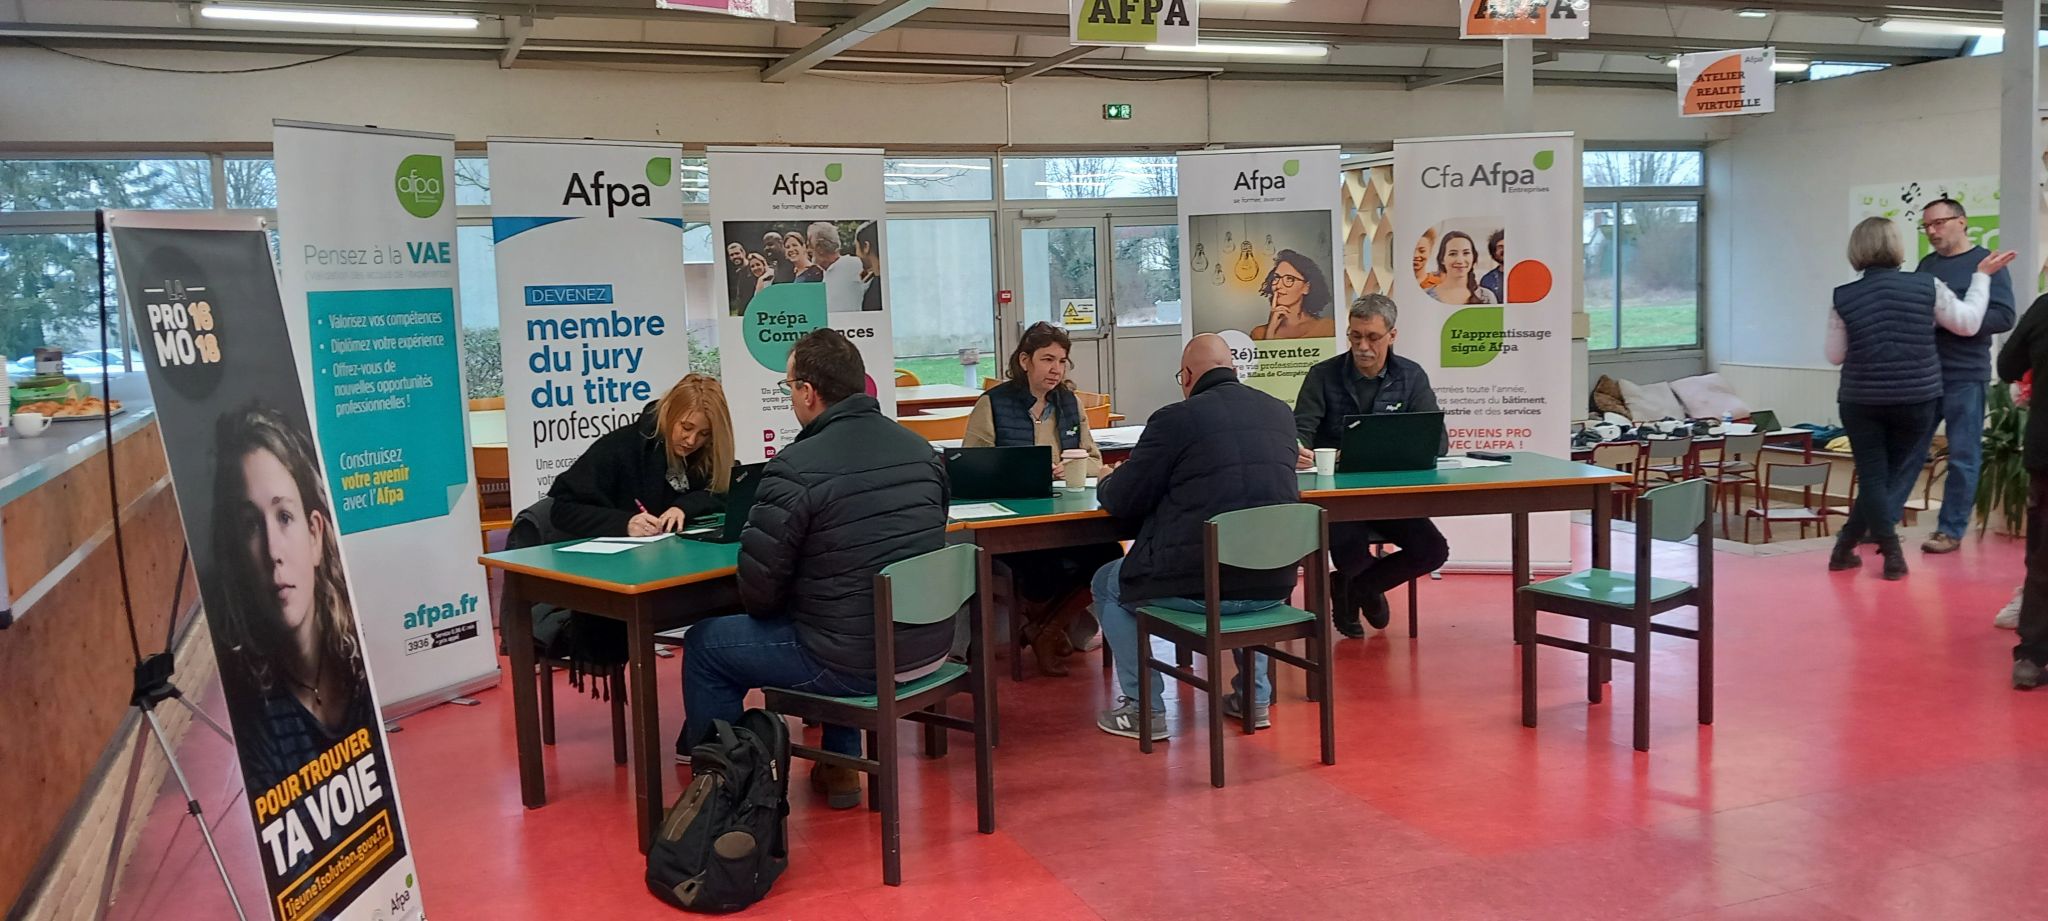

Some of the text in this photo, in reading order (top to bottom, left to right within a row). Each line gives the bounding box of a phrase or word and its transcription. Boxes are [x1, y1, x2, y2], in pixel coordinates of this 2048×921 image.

[1088, 0, 1190, 26] AFPA
[1474, 0, 1578, 19] APA
[1696, 71, 1745, 82] ATELIER
[1697, 85, 1746, 96] REALITE
[1697, 98, 1761, 110] VIRTUELLE
[398, 169, 440, 203] afpa
[772, 172, 829, 203] Afpa
[1233, 169, 1285, 196] Afpa
[1421, 161, 1535, 194] Cfa Afpa
[562, 171, 651, 218] Afpa
[1508, 186, 1549, 195] Entreprises
[304, 241, 452, 266] Pensez à la VAE
[532, 288, 607, 303] DEVENEZ
[147, 303, 189, 331] PRO
[328, 311, 442, 329] Valorisez vos compétences
[527, 310, 665, 341] membre
[757, 311, 808, 328] Prépa
[331, 333, 444, 354] Diplômez votre expérience
[1451, 328, 1552, 341] L'apprentissage
[153, 329, 197, 367] MO
[529, 343, 643, 376] du jury
[1231, 346, 1320, 362] Ré)inventez
[1451, 342, 1519, 354] signé Afpa
[332, 359, 396, 377] Offrez-vous de
[334, 373, 433, 397] nouvelles opportunités
[531, 376, 651, 409] du titre
[1466, 385, 1490, 394] toute
[335, 395, 406, 418] professionnelles
[1449, 396, 1486, 405] secteurs
[1488, 395, 1500, 405] du
[1501, 395, 1548, 405] bâtiment,
[1474, 408, 1483, 416] et
[1485, 407, 1502, 416] des
[1503, 406, 1542, 416] services
[533, 407, 642, 448] profession
[1449, 428, 1533, 438] DEVIENS PRO
[1448, 440, 1472, 449] VEC
[1475, 440, 1515, 449] L'AFPA
[340, 447, 403, 470] Construisez
[535, 458, 553, 470] Une
[341, 464, 410, 491] votre avenir
[343, 486, 405, 512] avec l'Afpa
[403, 593, 478, 630] afpa.fr
[407, 638, 430, 652] 3936
[255, 727, 372, 824] POUR TROUVER
[261, 752, 383, 877] TA VOIE
[285, 824, 387, 918] 1jeune1solution.gouv.fr
[390, 890, 410, 915] Afpa
